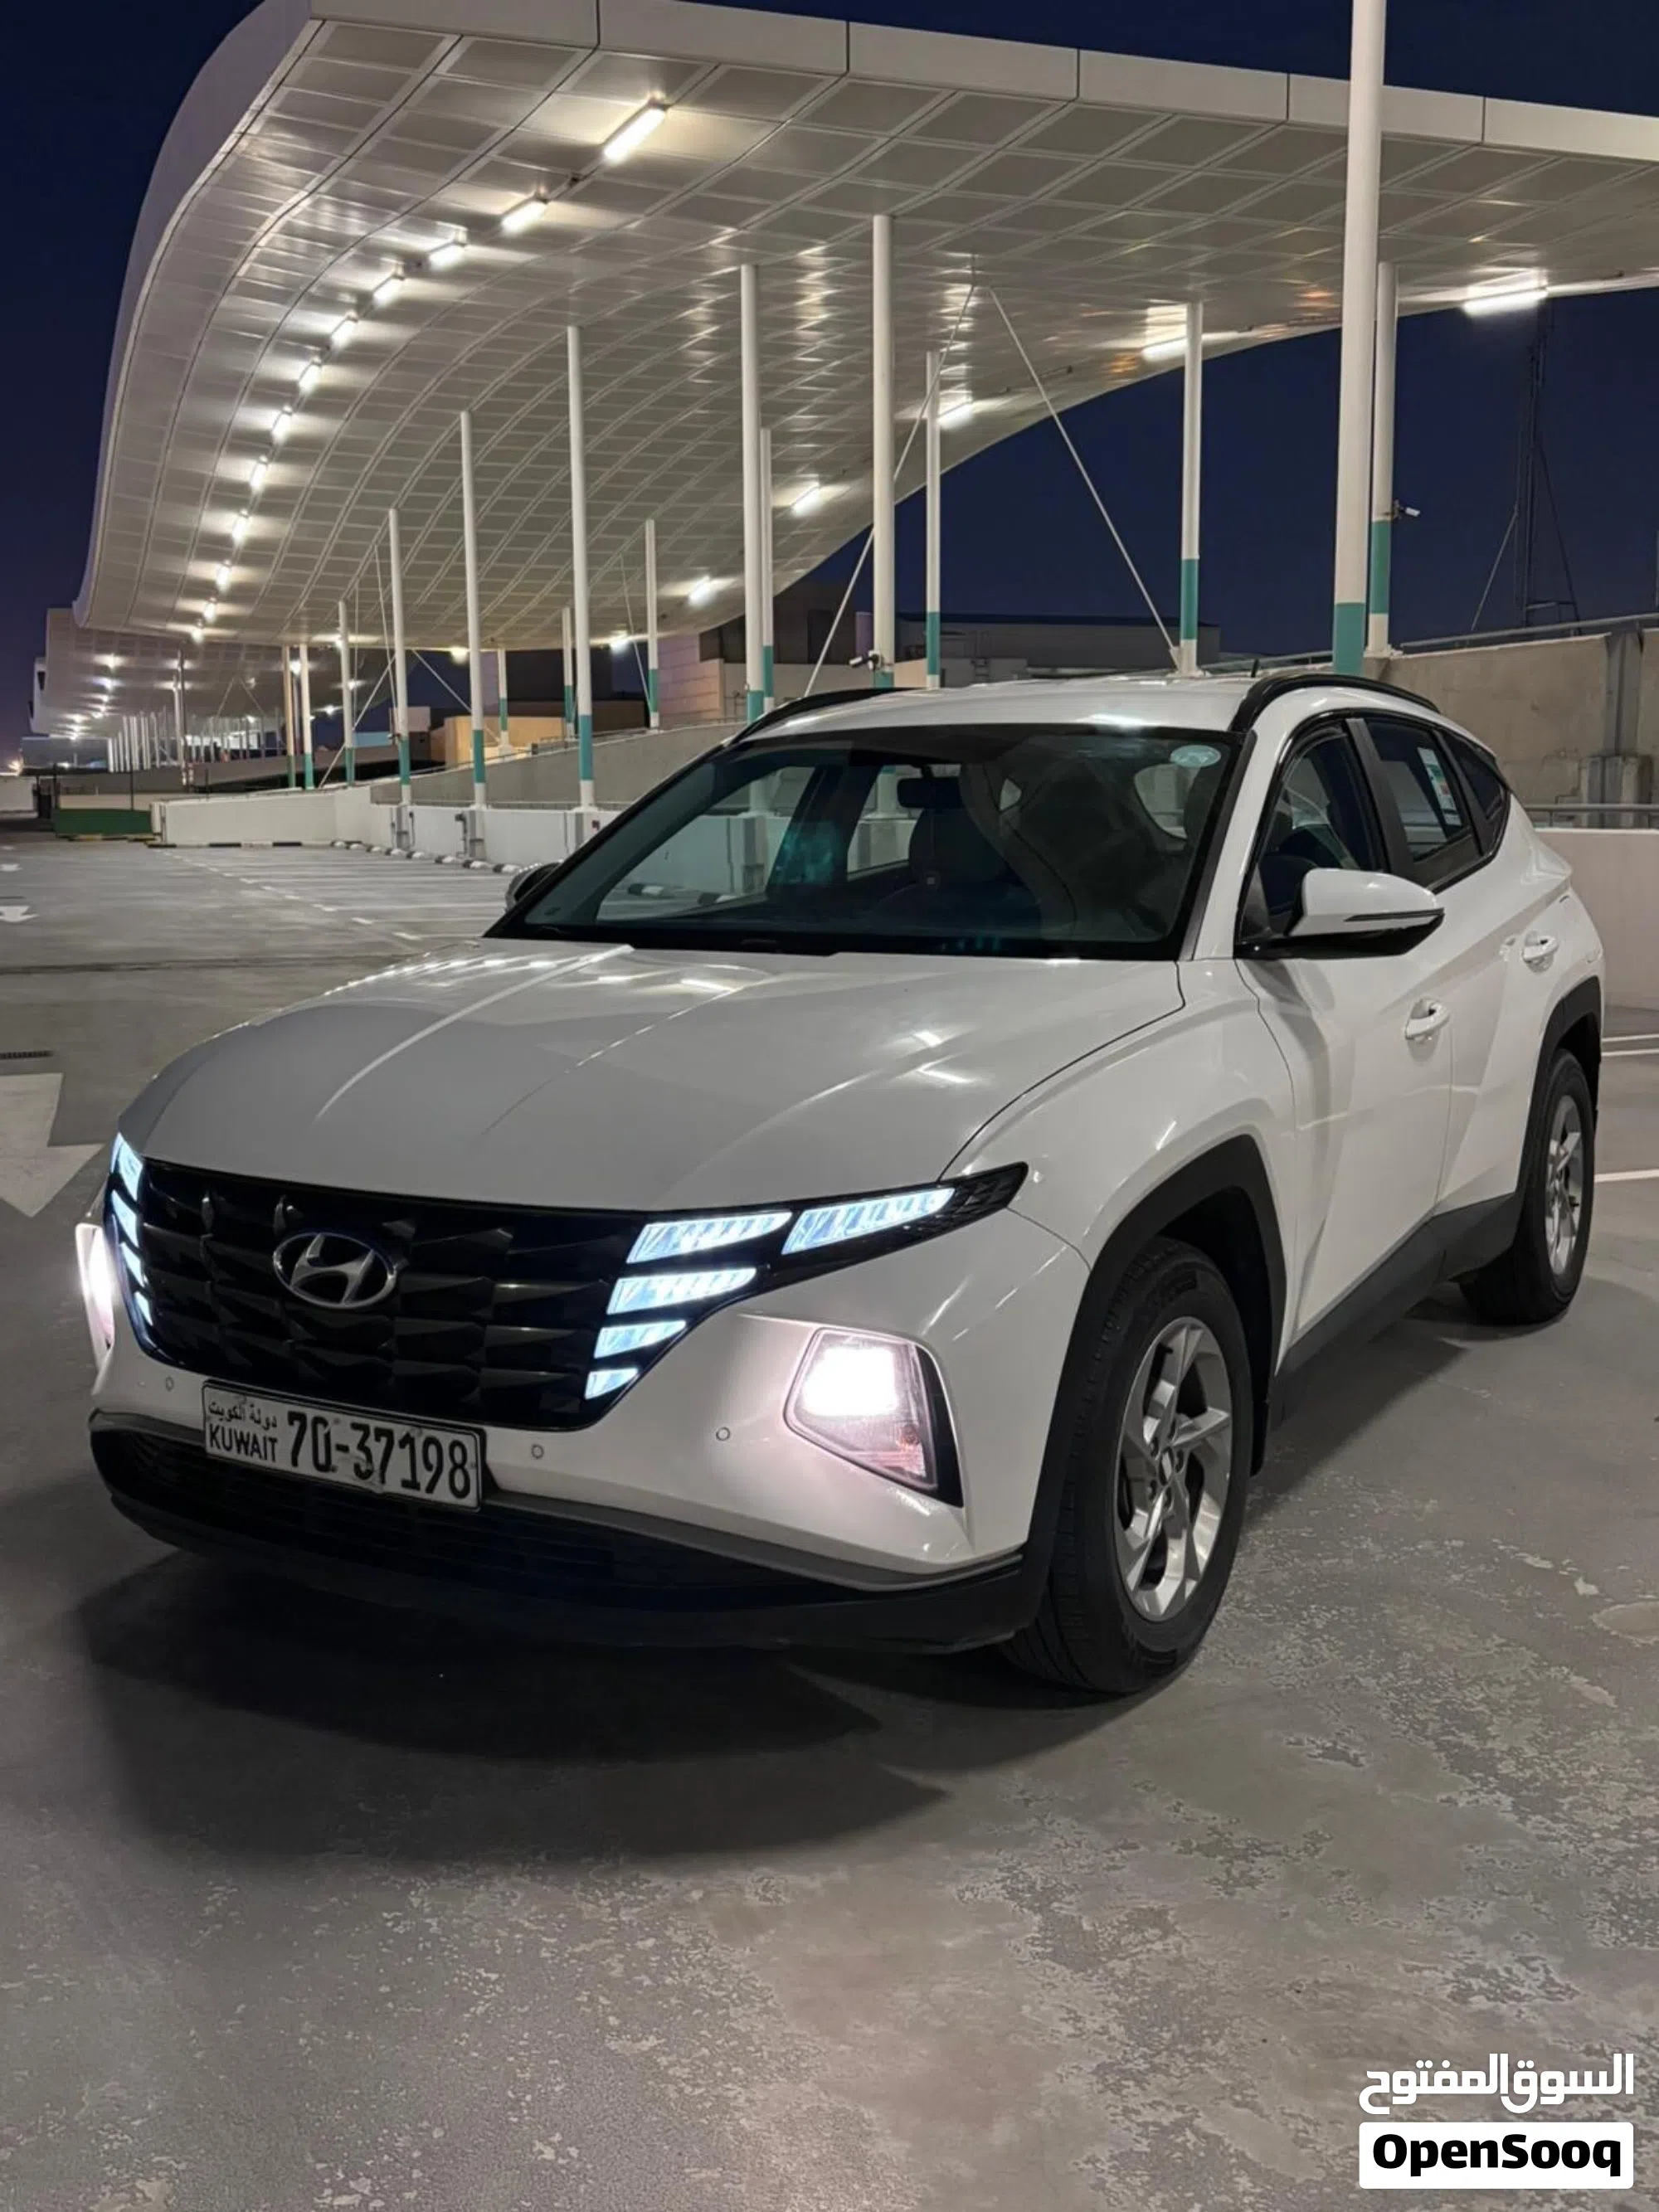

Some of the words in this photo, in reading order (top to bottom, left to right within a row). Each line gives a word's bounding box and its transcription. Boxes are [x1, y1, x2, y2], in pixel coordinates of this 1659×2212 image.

[208, 1402, 246, 1422] الكويت
[249, 1403, 278, 1430] دولة
[209, 1423, 278, 1462] KUWAIT
[287, 1411, 471, 1499] 70-37198
